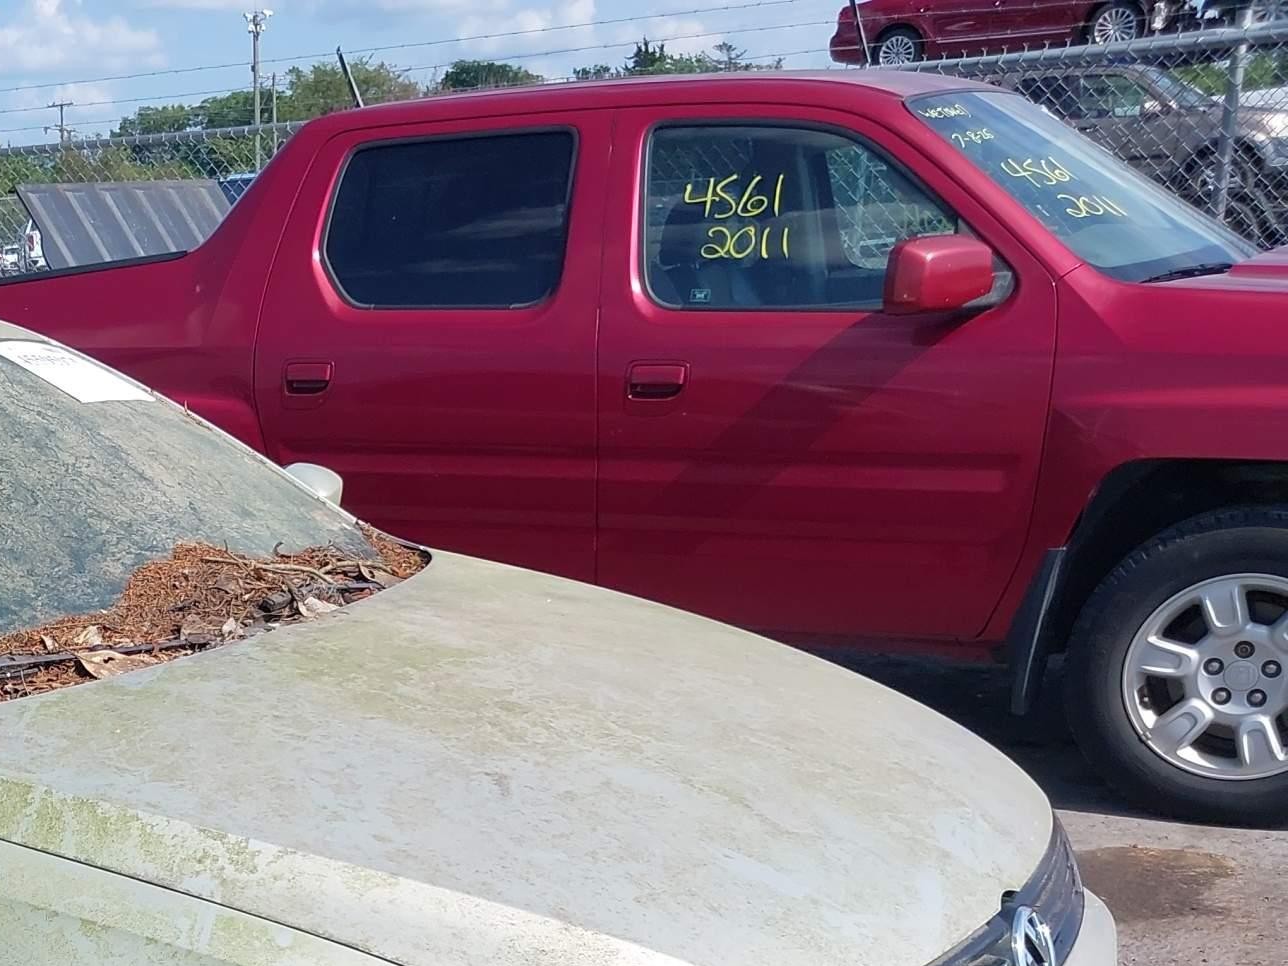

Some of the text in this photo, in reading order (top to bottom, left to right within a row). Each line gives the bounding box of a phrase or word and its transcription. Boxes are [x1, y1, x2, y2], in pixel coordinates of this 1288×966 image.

[1000, 156, 1079, 188] 4561
[684, 173, 784, 218] 4561
[1057, 194, 1128, 218] 2011
[700, 225, 789, 260] 2011
